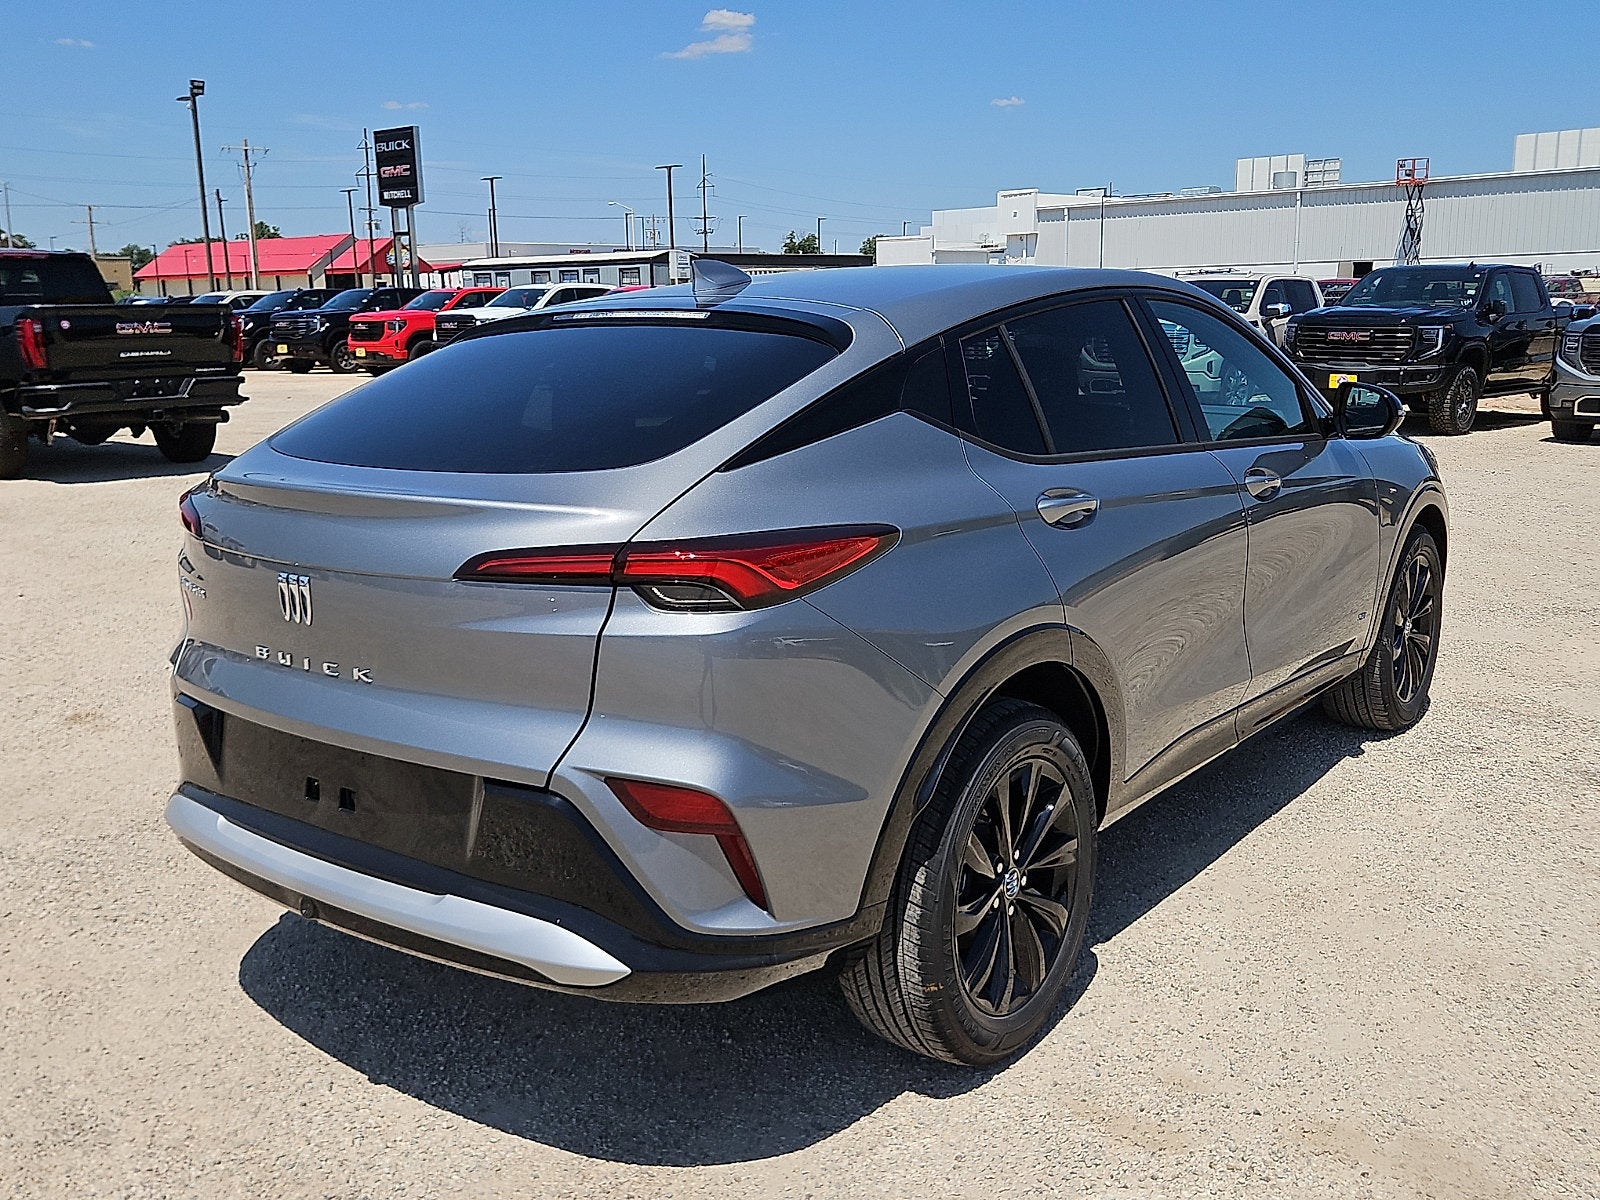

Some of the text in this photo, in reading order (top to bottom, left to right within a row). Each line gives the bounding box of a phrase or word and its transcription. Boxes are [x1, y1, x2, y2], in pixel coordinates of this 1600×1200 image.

[375, 139, 411, 153] BUICK
[380, 164, 411, 178] GMC
[383, 190, 412, 200] MITCHELL
[116, 321, 172, 335] GMC
[1327, 331, 1370, 341] GMC
[255, 644, 374, 684] BUICK
